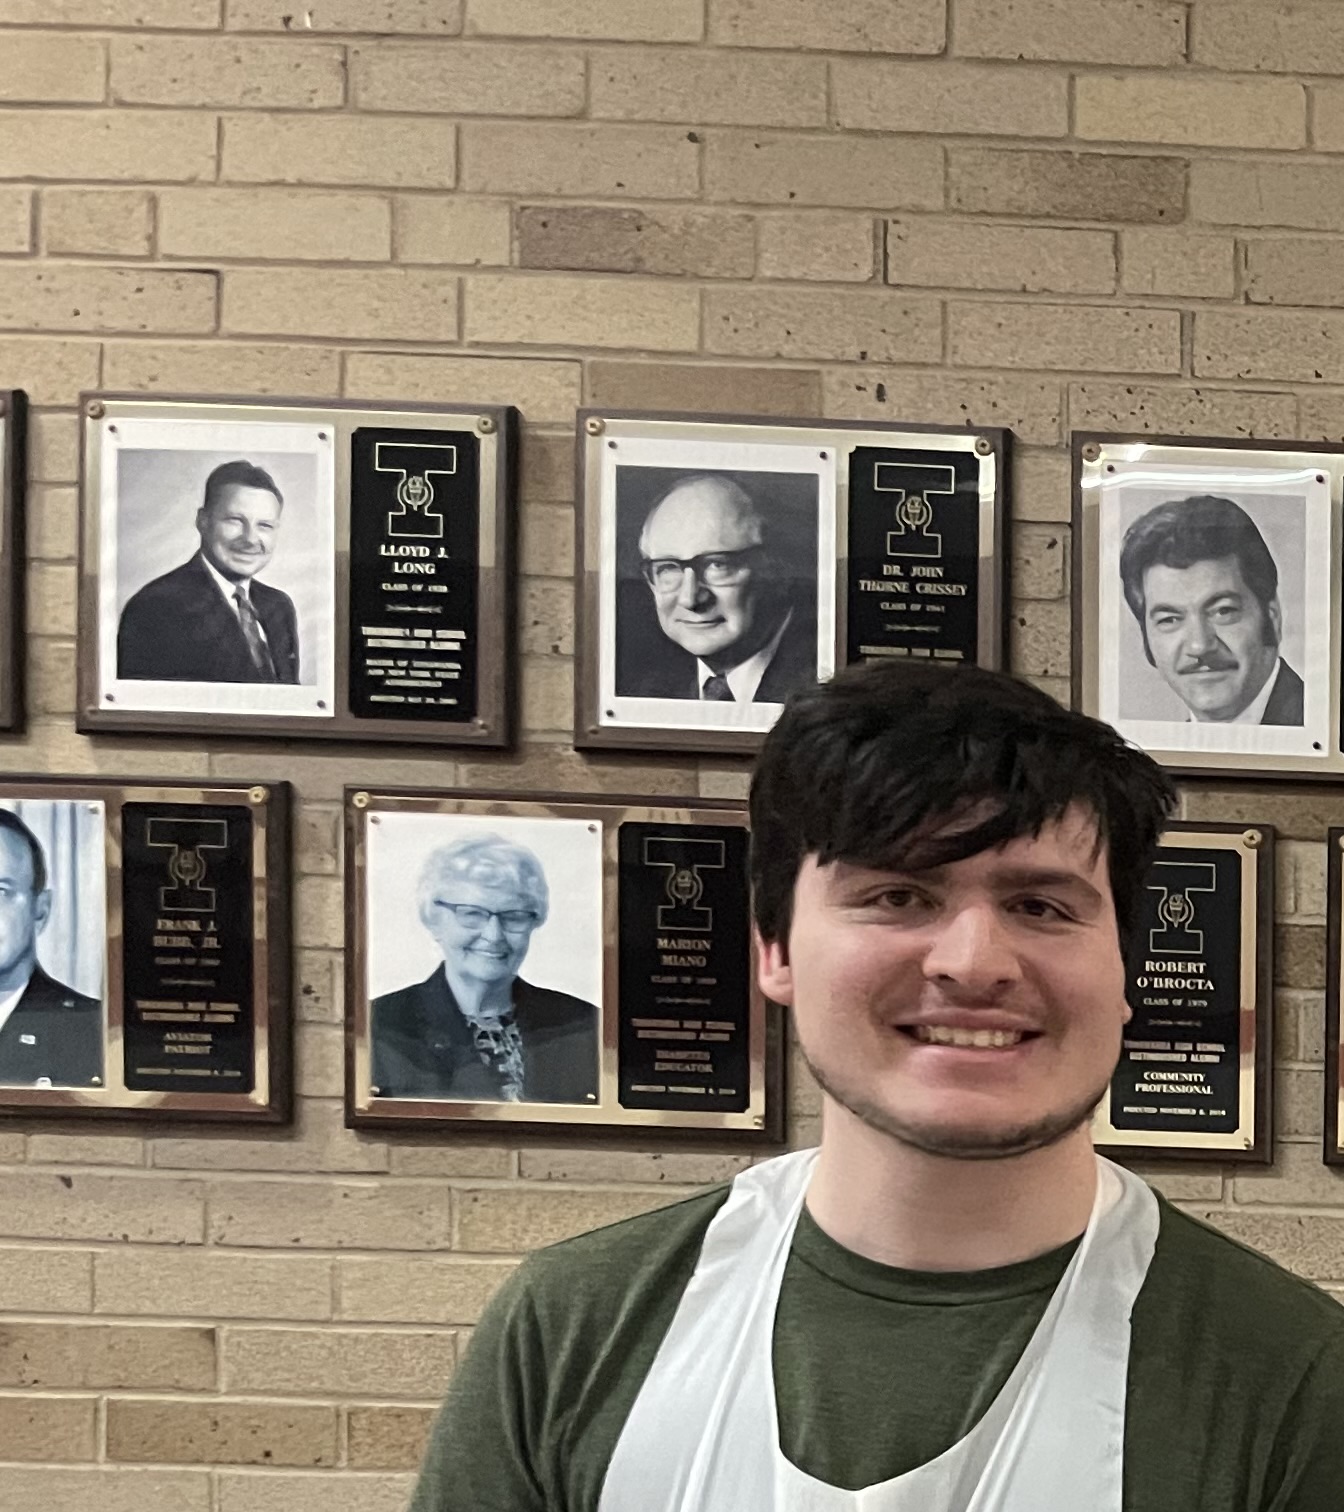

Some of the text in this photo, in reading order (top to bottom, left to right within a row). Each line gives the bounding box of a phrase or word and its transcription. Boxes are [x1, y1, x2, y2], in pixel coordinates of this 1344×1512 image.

[380, 544, 448, 558] LLOYD J.
[394, 562, 435, 574] LONG
[883, 564, 944, 578] DR. JOHN
[859, 580, 967, 595] THORNE CRISSEY
[657, 938, 712, 950] MARION
[661, 955, 706, 967] MIANO
[1145, 961, 1207, 973] ROBERT
[1137, 977, 1214, 990] O'BROCTA
[1143, 998, 1169, 1006] CLASS
[1143, 1071, 1206, 1082] COMMUNITY
[1135, 1083, 1213, 1095] PROFESSIONAL
